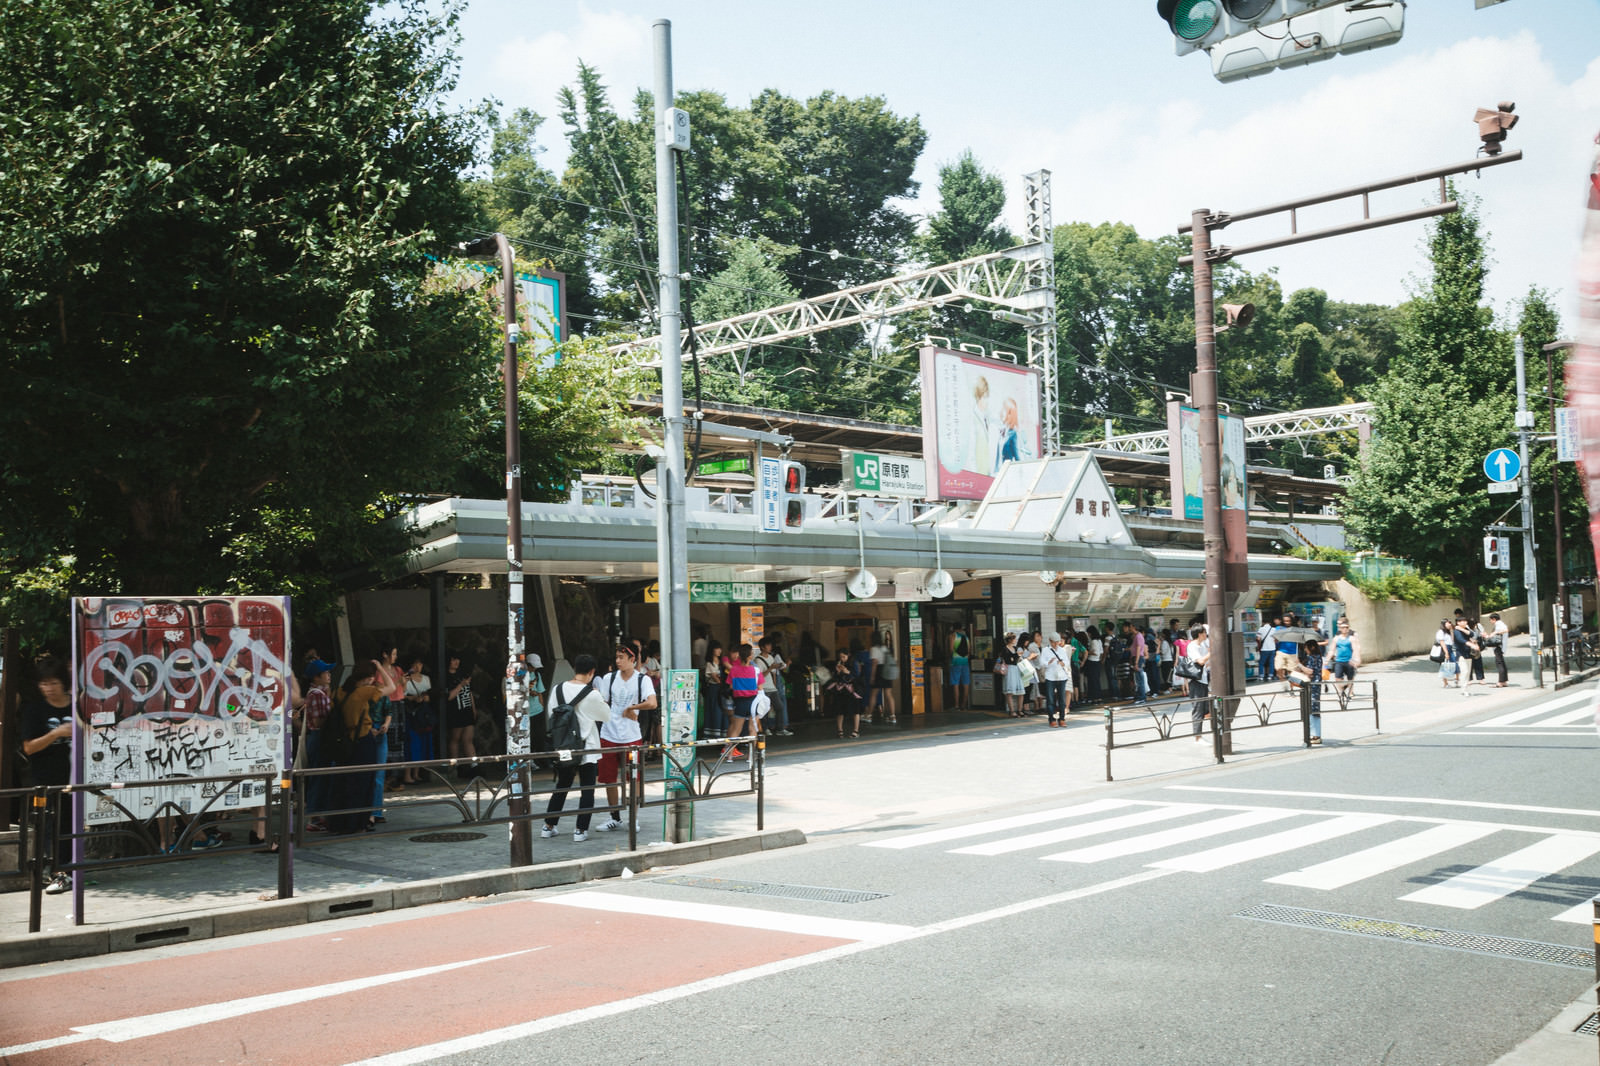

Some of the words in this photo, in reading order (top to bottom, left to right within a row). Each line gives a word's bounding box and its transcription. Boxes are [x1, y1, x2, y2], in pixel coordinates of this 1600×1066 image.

[856, 459, 878, 479] JR
[882, 462, 910, 479] 原宿駅
[882, 481, 905, 489] Harajuku
[906, 482, 924, 490] Station
[1076, 498, 1111, 518] 原宿駅
